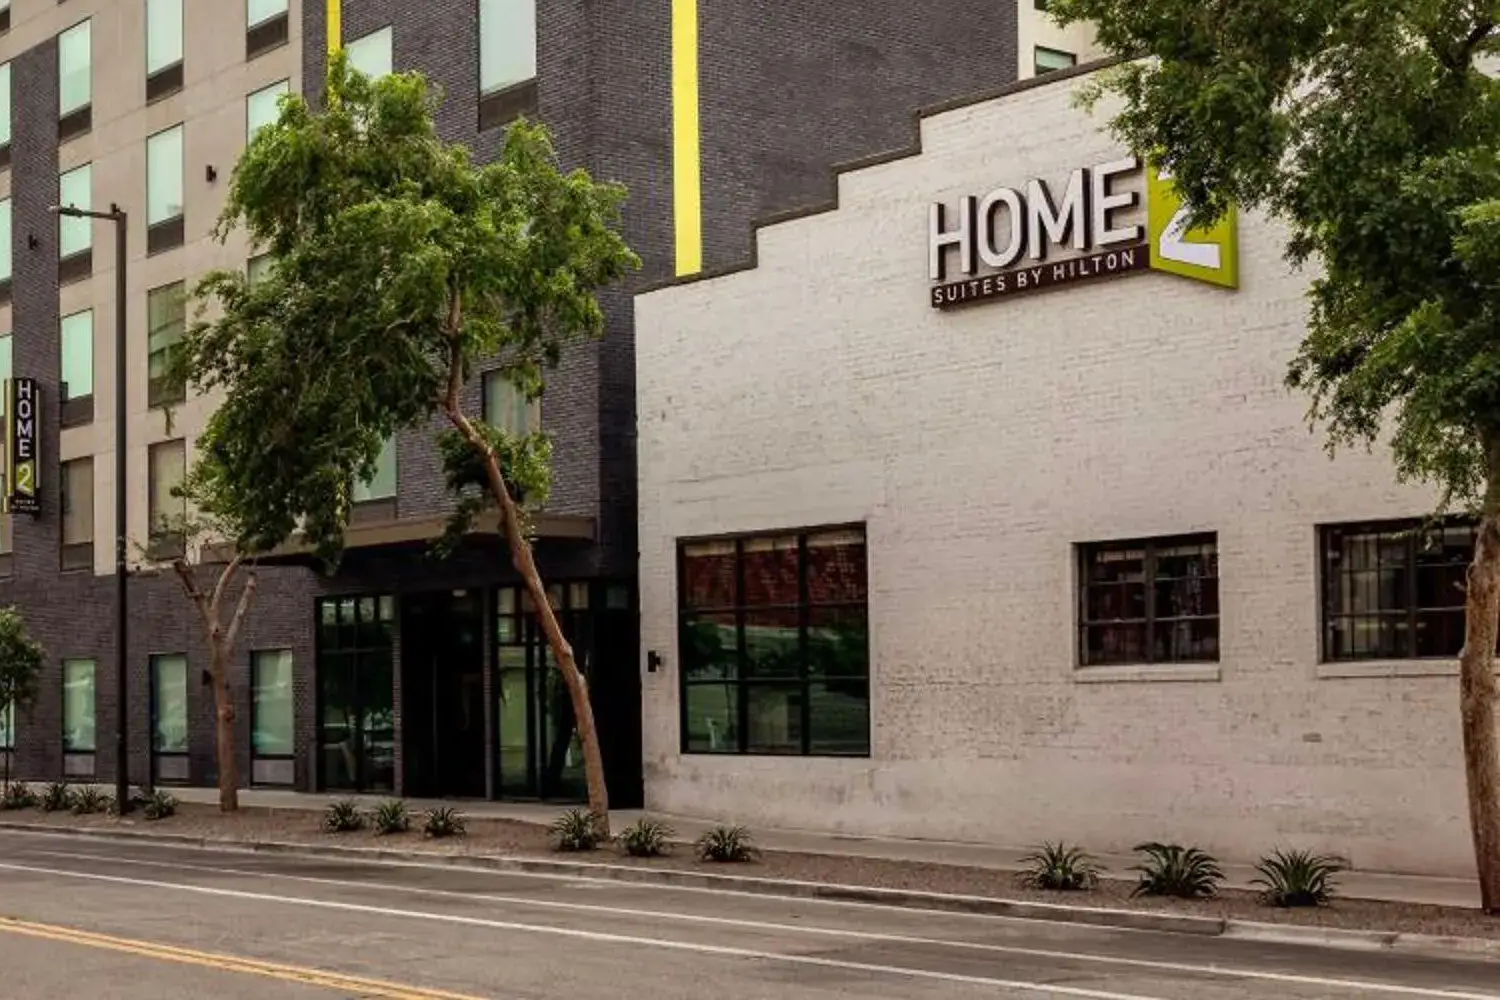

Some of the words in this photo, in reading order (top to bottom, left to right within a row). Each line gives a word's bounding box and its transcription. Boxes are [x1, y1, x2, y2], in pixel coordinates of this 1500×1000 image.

[934, 276, 1005, 303] SUITES
[1017, 269, 1042, 288] BY
[1053, 251, 1134, 280] HILTON
